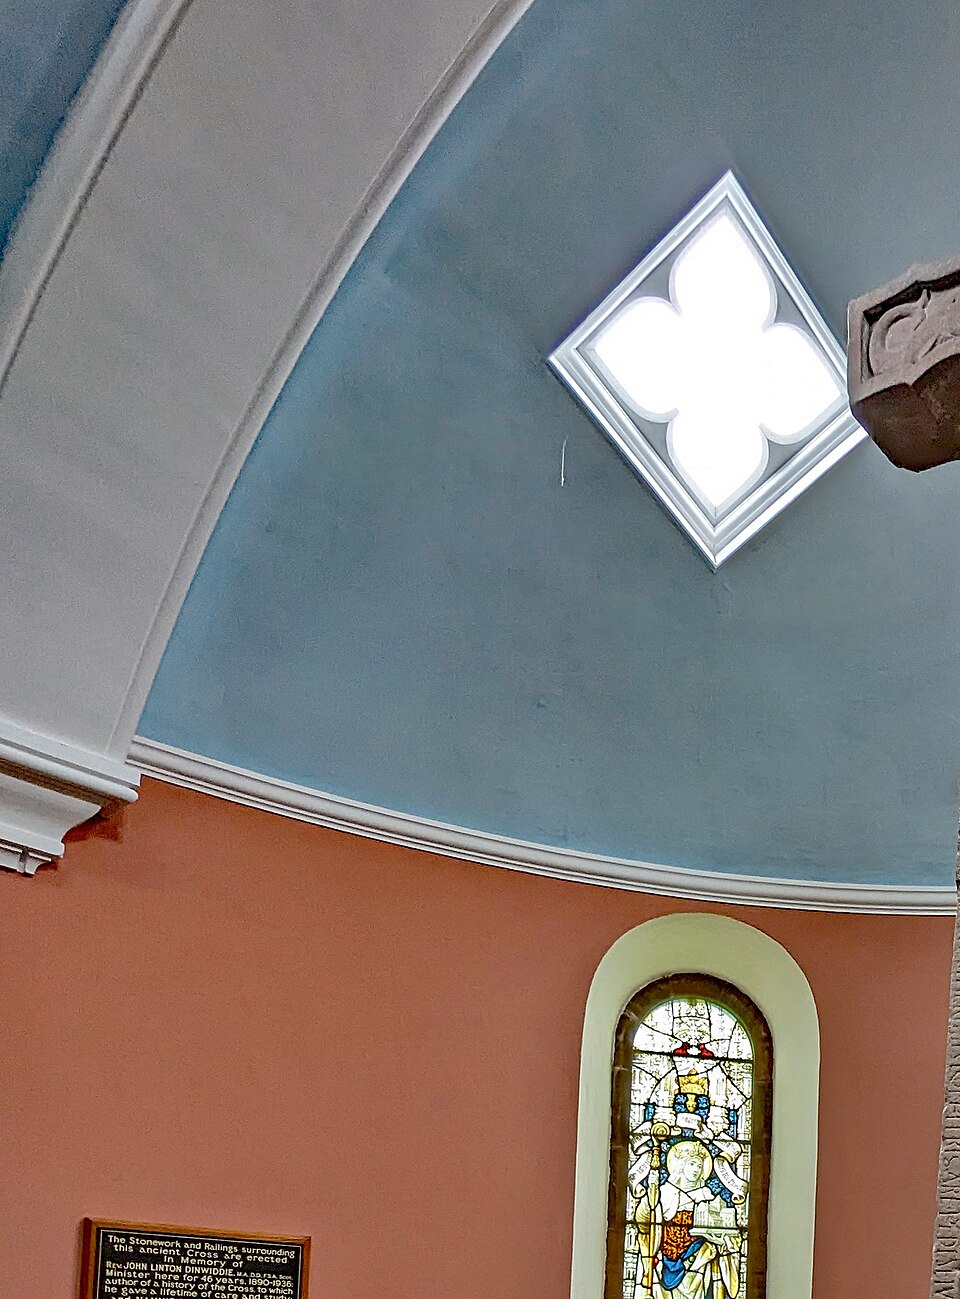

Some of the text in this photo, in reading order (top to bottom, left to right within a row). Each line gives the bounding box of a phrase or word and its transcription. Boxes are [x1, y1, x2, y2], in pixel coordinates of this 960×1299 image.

[113, 1244, 134, 1252] this
[139, 1247, 181, 1256] ancient
[187, 1249, 218, 1258] Cross
[247, 1255, 287, 1264] erected
[129, 1237, 181, 1248] Stonework
[204, 1243, 238, 1253] Railings
[242, 1247, 295, 1259] surrounding
[124, 1262, 147, 1270] JOHN
[150, 1263, 182, 1272] LINTON
[180, 1256, 226, 1268] Memory
[105, 1269, 150, 1278] Minister
[155, 1272, 180, 1280] here
[121, 1286, 148, 1296] gave
[160, 1288, 198, 1297] lifetime
[162, 1280, 196, 1290] history
[268, 1287, 293, 1295] which
